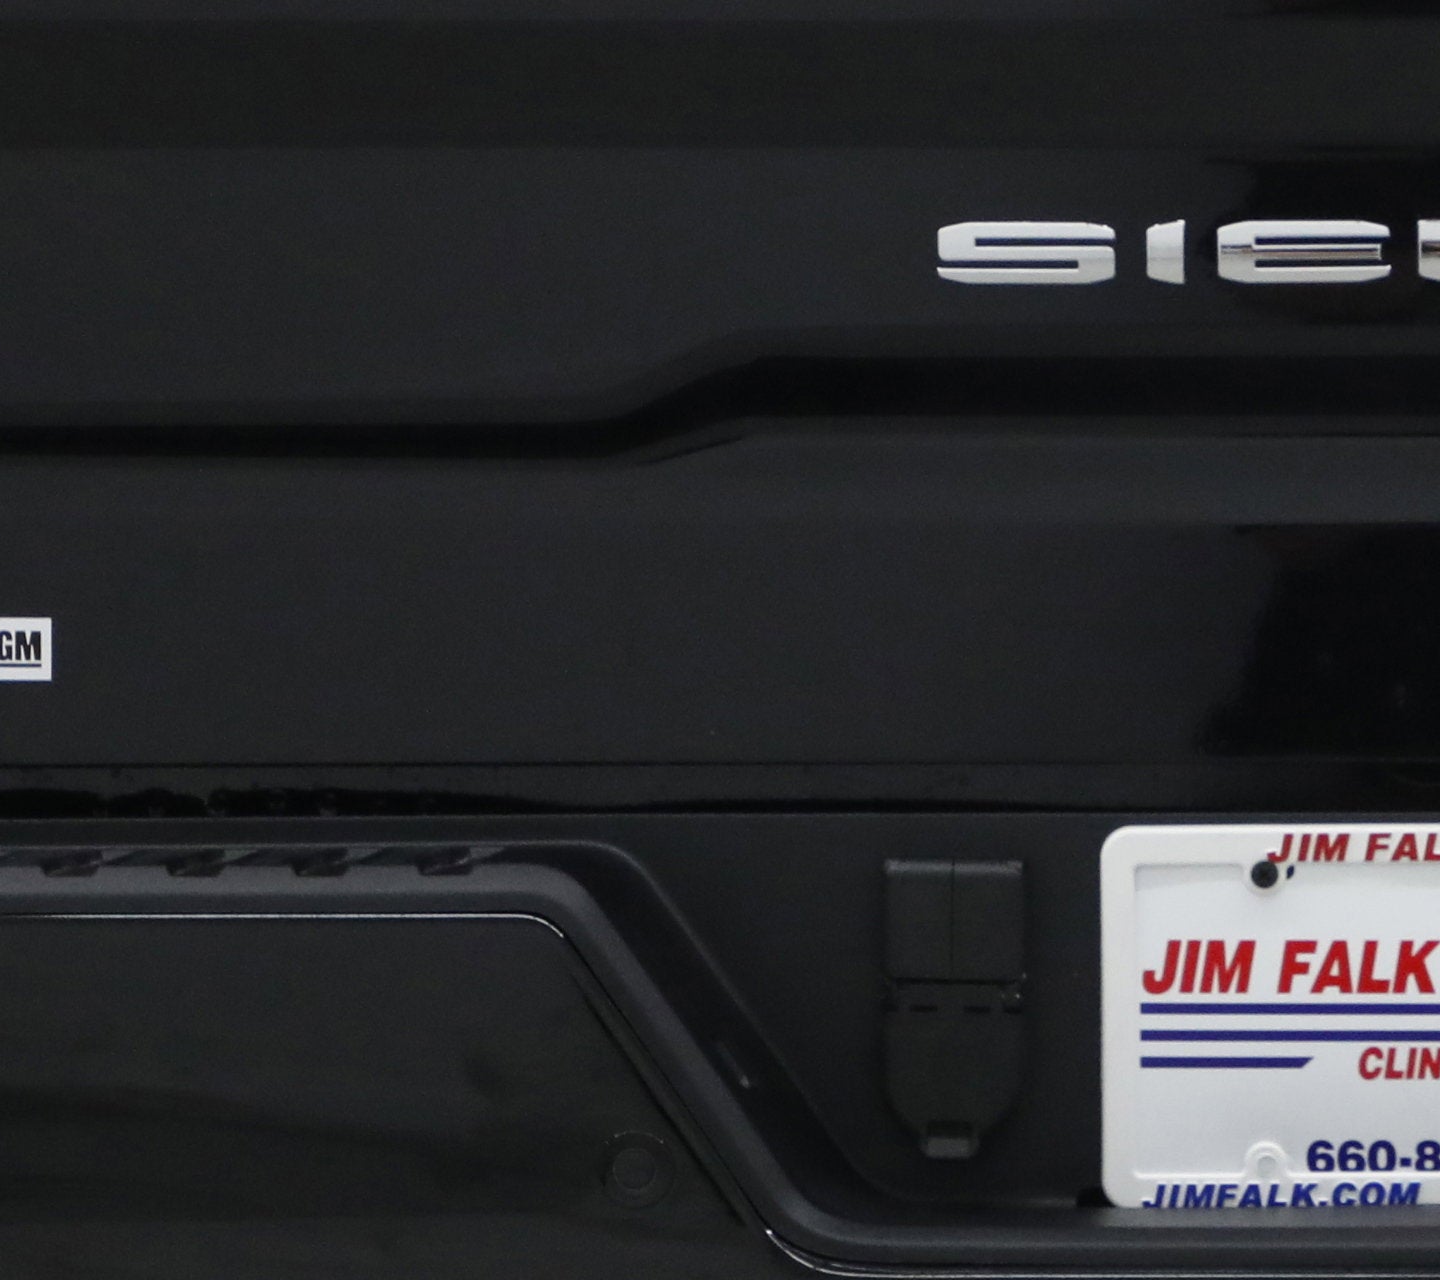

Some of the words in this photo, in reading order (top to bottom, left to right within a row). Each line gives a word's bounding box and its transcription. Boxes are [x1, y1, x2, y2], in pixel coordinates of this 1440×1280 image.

[1267, 833, 1349, 863] JIM
[1142, 939, 1256, 995] JIM
[1140, 1182, 1422, 1208] JIMFALK.COM
